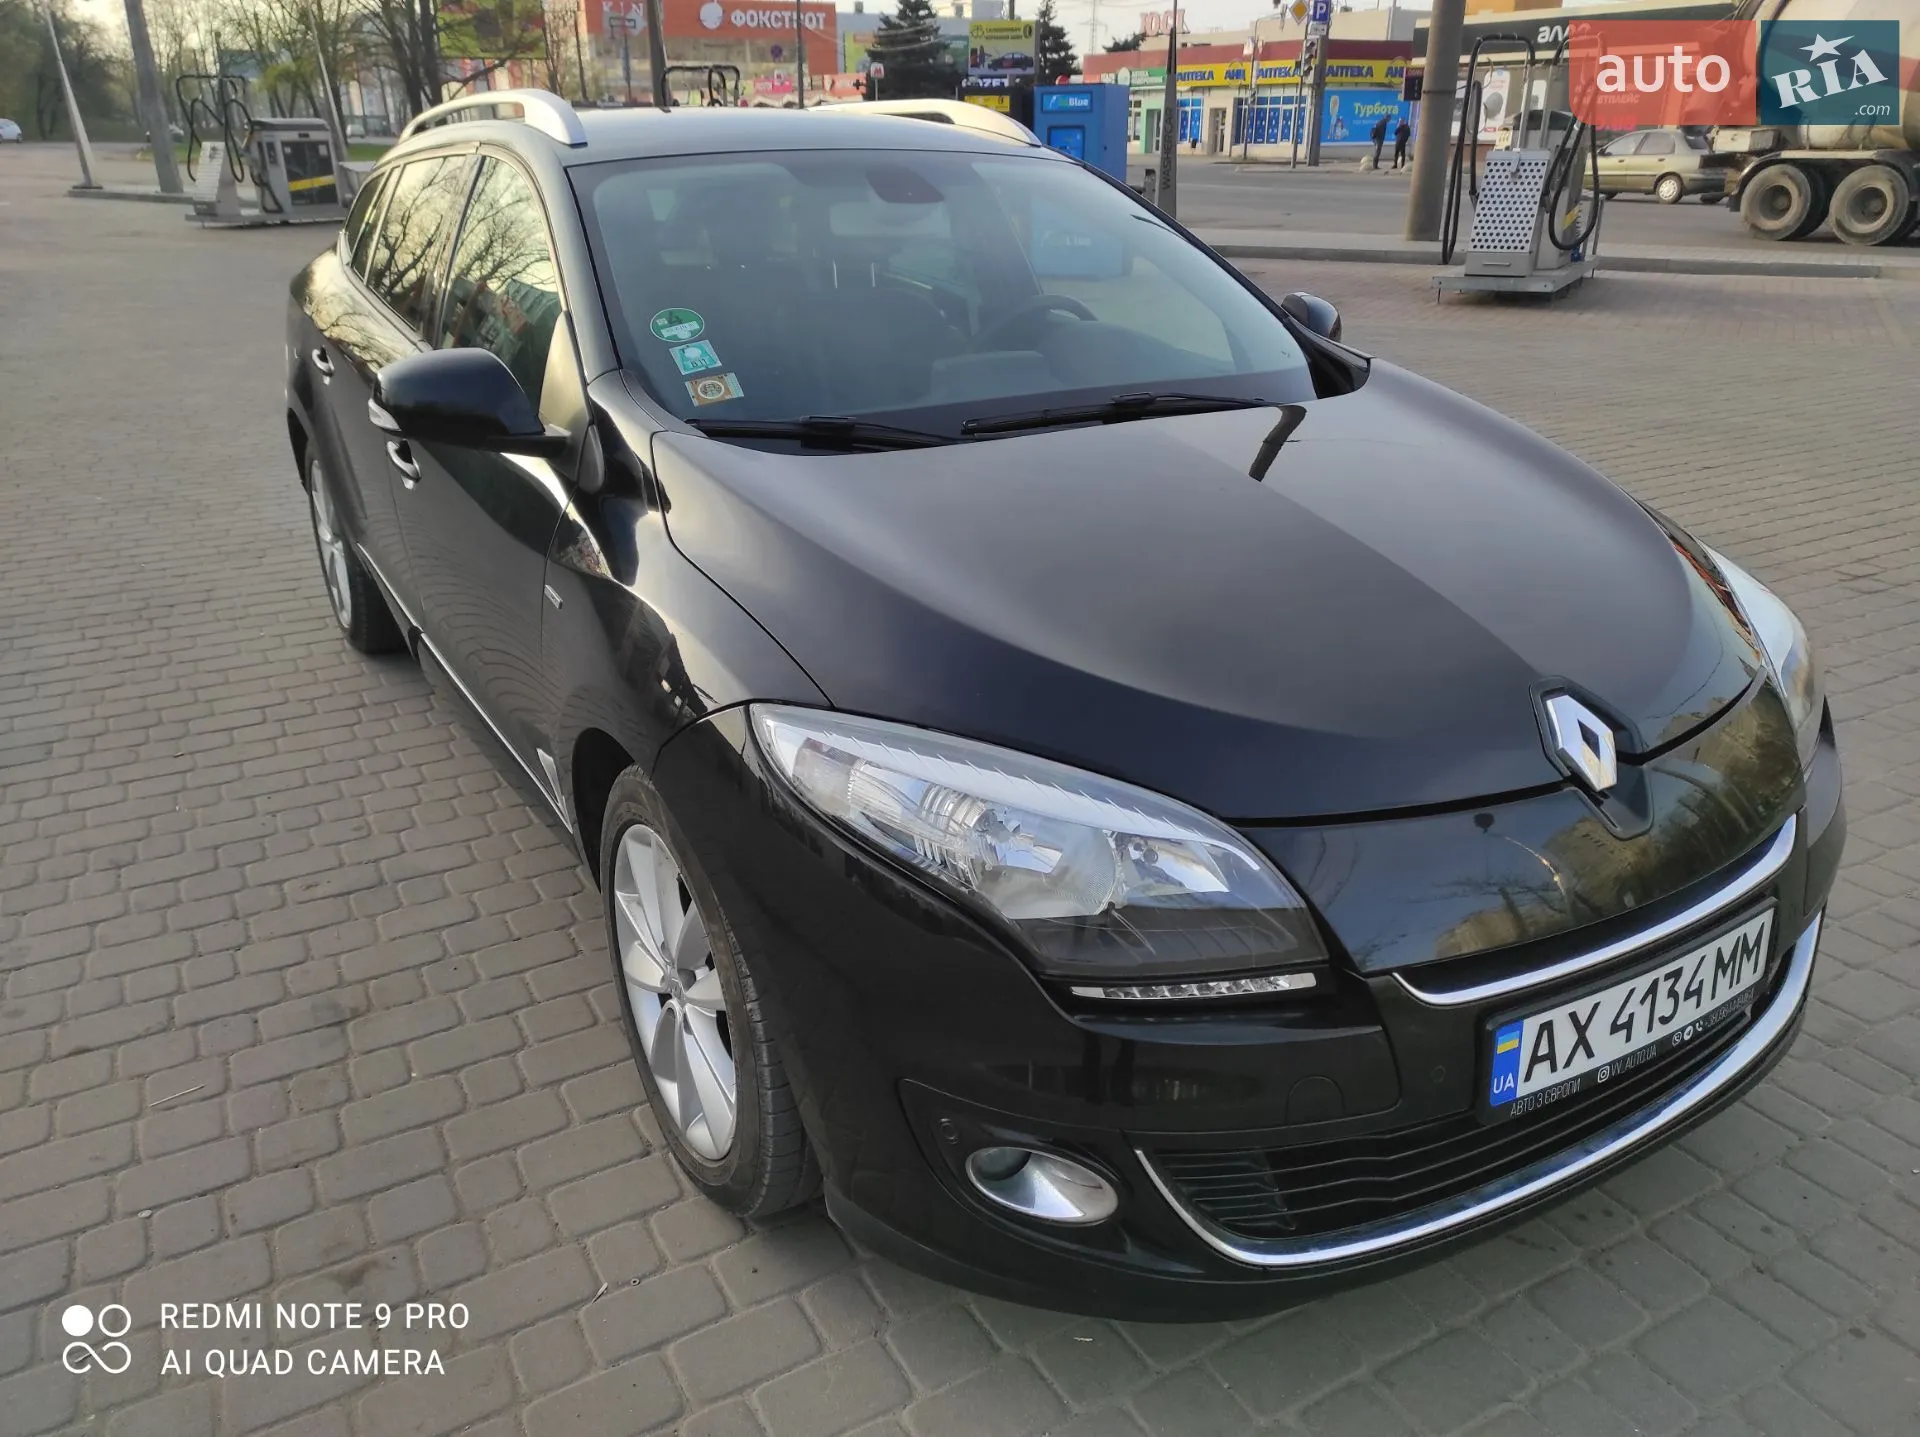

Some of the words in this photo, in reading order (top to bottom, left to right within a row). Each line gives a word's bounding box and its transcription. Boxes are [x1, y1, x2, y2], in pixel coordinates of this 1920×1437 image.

[731, 9, 826, 30] ФОКСТРОТ
[1316, 2, 1327, 19] P
[1176, 70, 1214, 81] АПТЕКА
[1256, 66, 1301, 79] АПТЕКА
[1325, 65, 1374, 78] АПТЕКА
[1385, 66, 1404, 78] АН
[1354, 102, 1399, 117] Турбота
[1524, 1001, 1601, 1083] AX
[1610, 955, 1706, 1044] 4134
[1711, 922, 1765, 1001] MM
[1493, 1072, 1515, 1094] UA
[1510, 1096, 1535, 1119] АВТО
[1545, 1078, 1581, 1105] ЄВРОПИ
